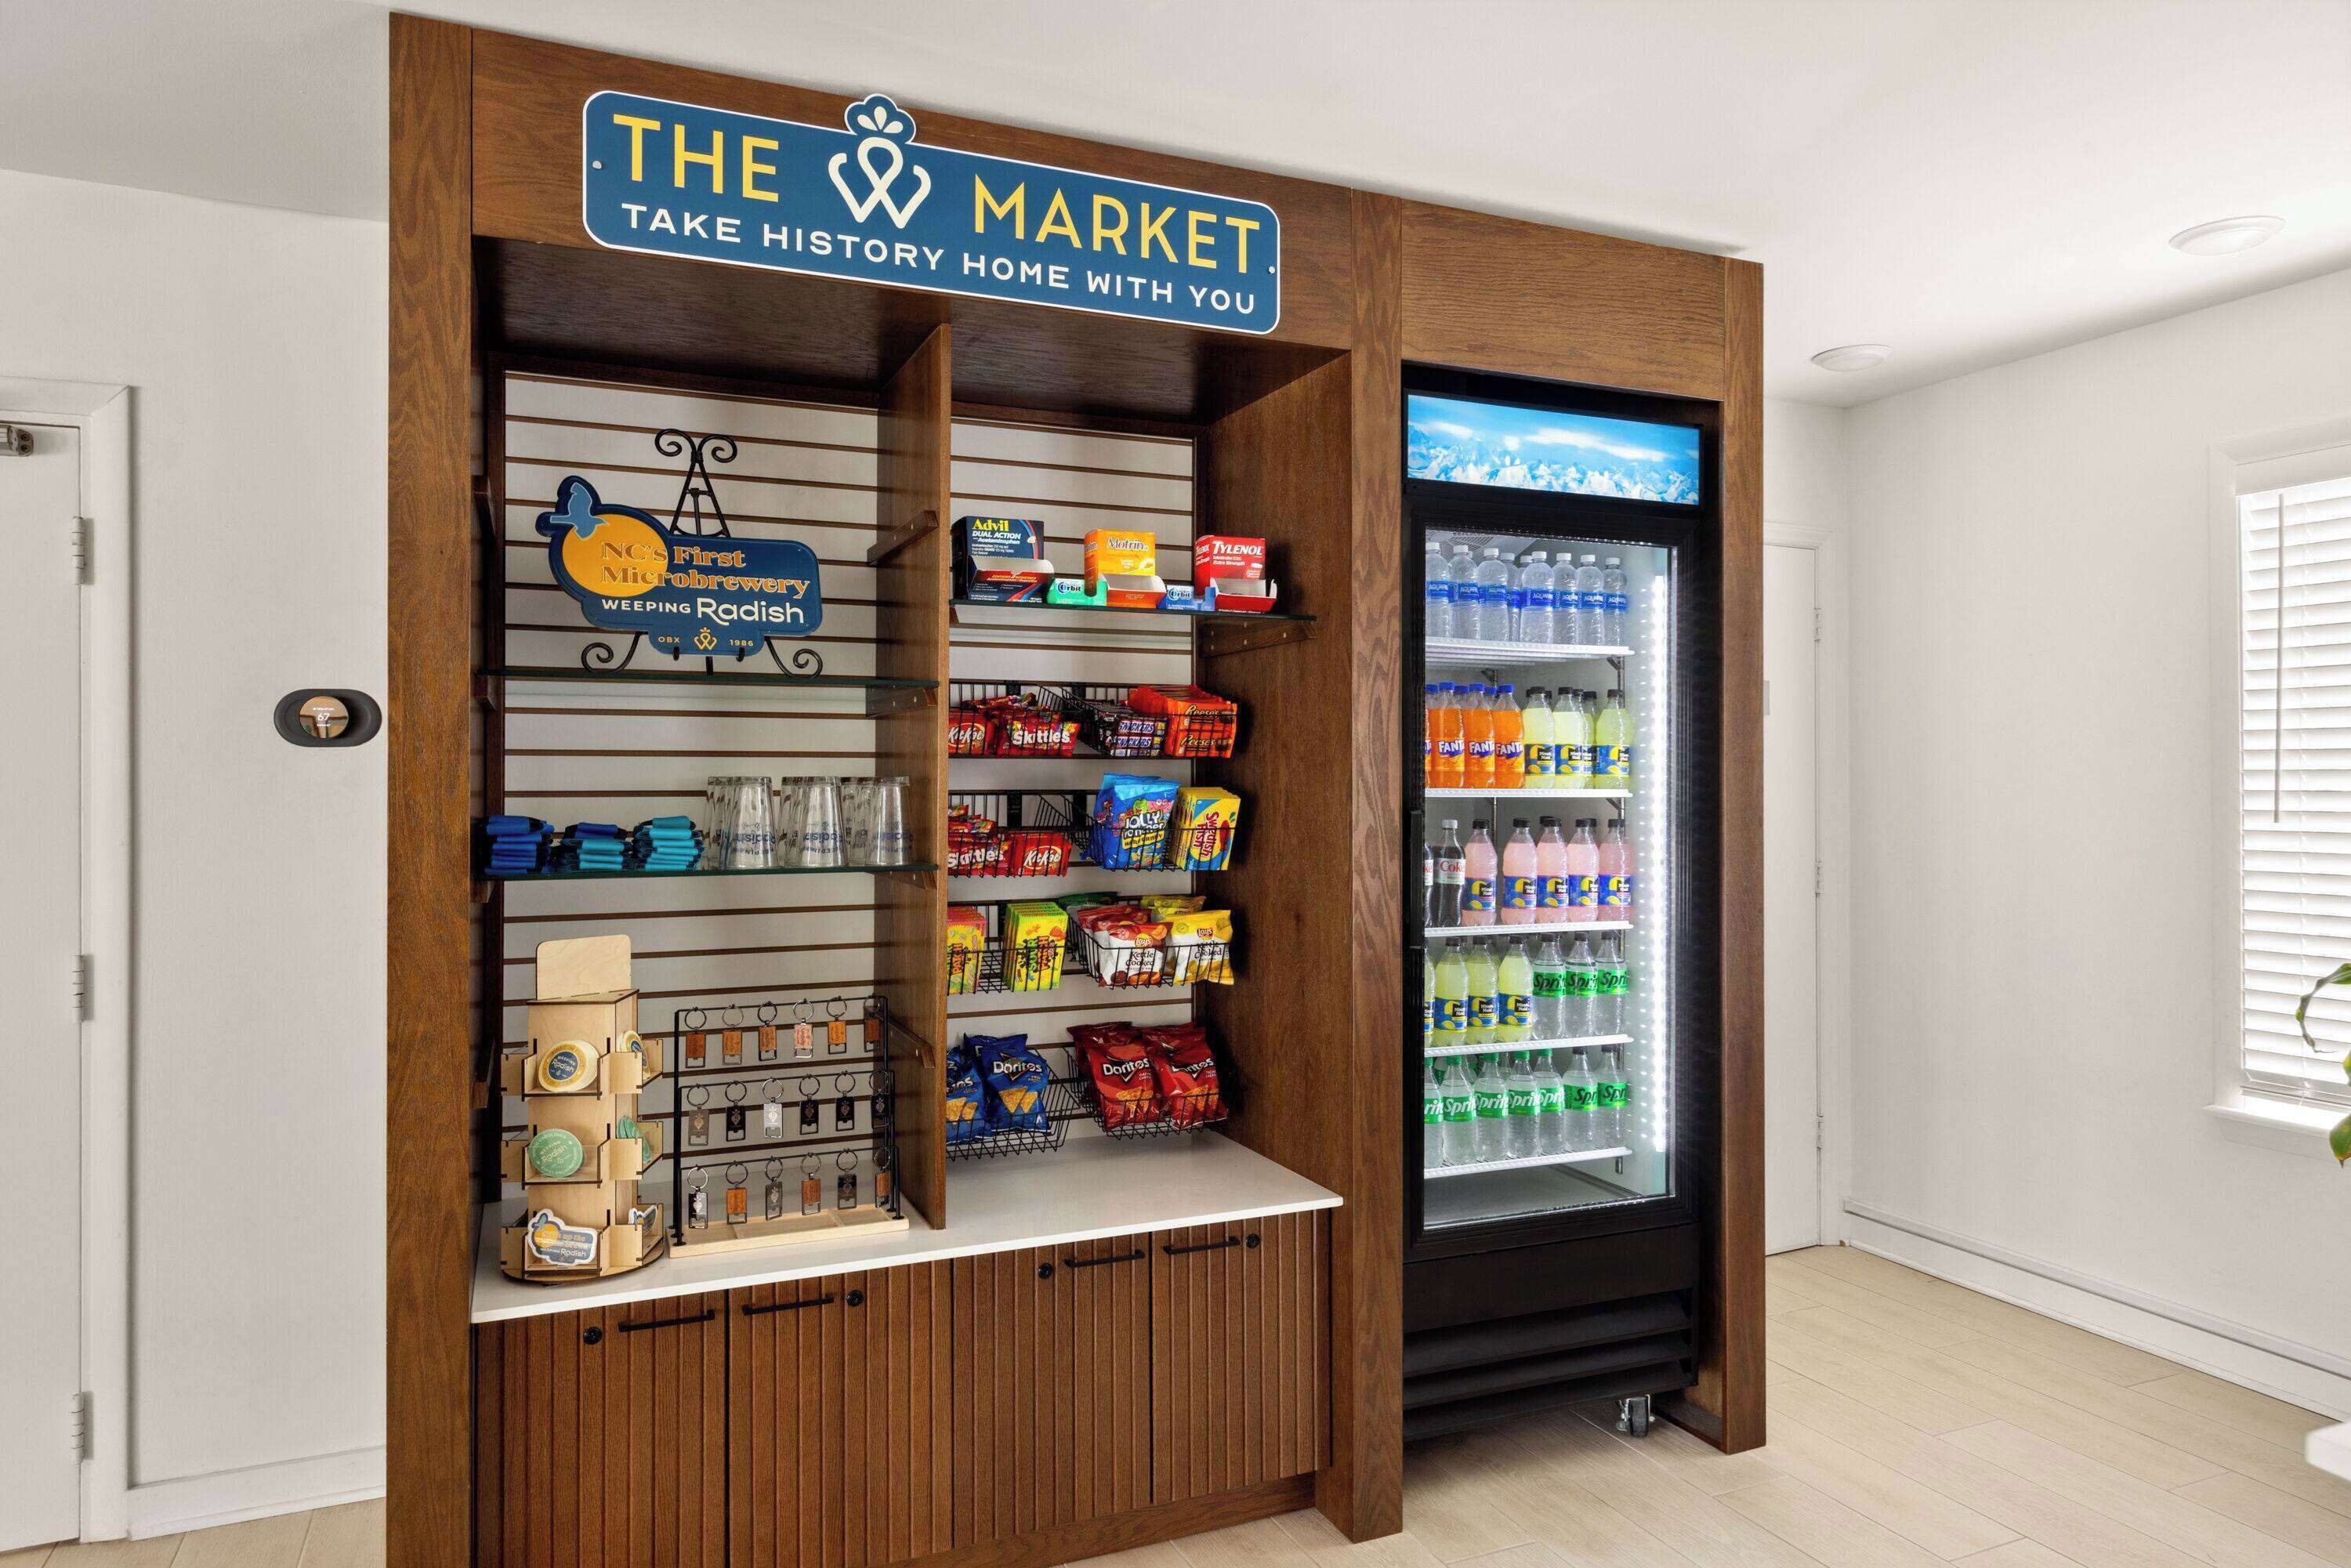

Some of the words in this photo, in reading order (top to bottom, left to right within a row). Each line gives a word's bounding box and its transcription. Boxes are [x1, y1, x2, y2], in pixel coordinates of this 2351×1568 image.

[614, 114, 779, 202] THE
[975, 173, 1260, 273] MARKET
[621, 203, 741, 243] TAKE
[763, 223, 944, 271] HISTORY
[963, 252, 1070, 289] HOME
[1087, 271, 1173, 303] WITH
[1189, 285, 1255, 314] YOU
[972, 519, 1009, 532] Advil
[1106, 537, 1144, 551] Motrin
[1212, 541, 1263, 556] TYLENOL
[601, 541, 668, 563] NC's
[674, 546, 747, 568] First
[601, 565, 810, 599] Microbrewery
[1057, 581, 1081, 595] Orbit
[602, 598, 690, 614] WEEPING
[697, 598, 804, 626] Radish
[1012, 730, 1072, 745] Skittles
[552, 1059, 574, 1073] Radish
[993, 1060, 1043, 1074] Doritos
[1103, 1058, 1150, 1076] Doritos
[560, 1248, 586, 1258] Radish
